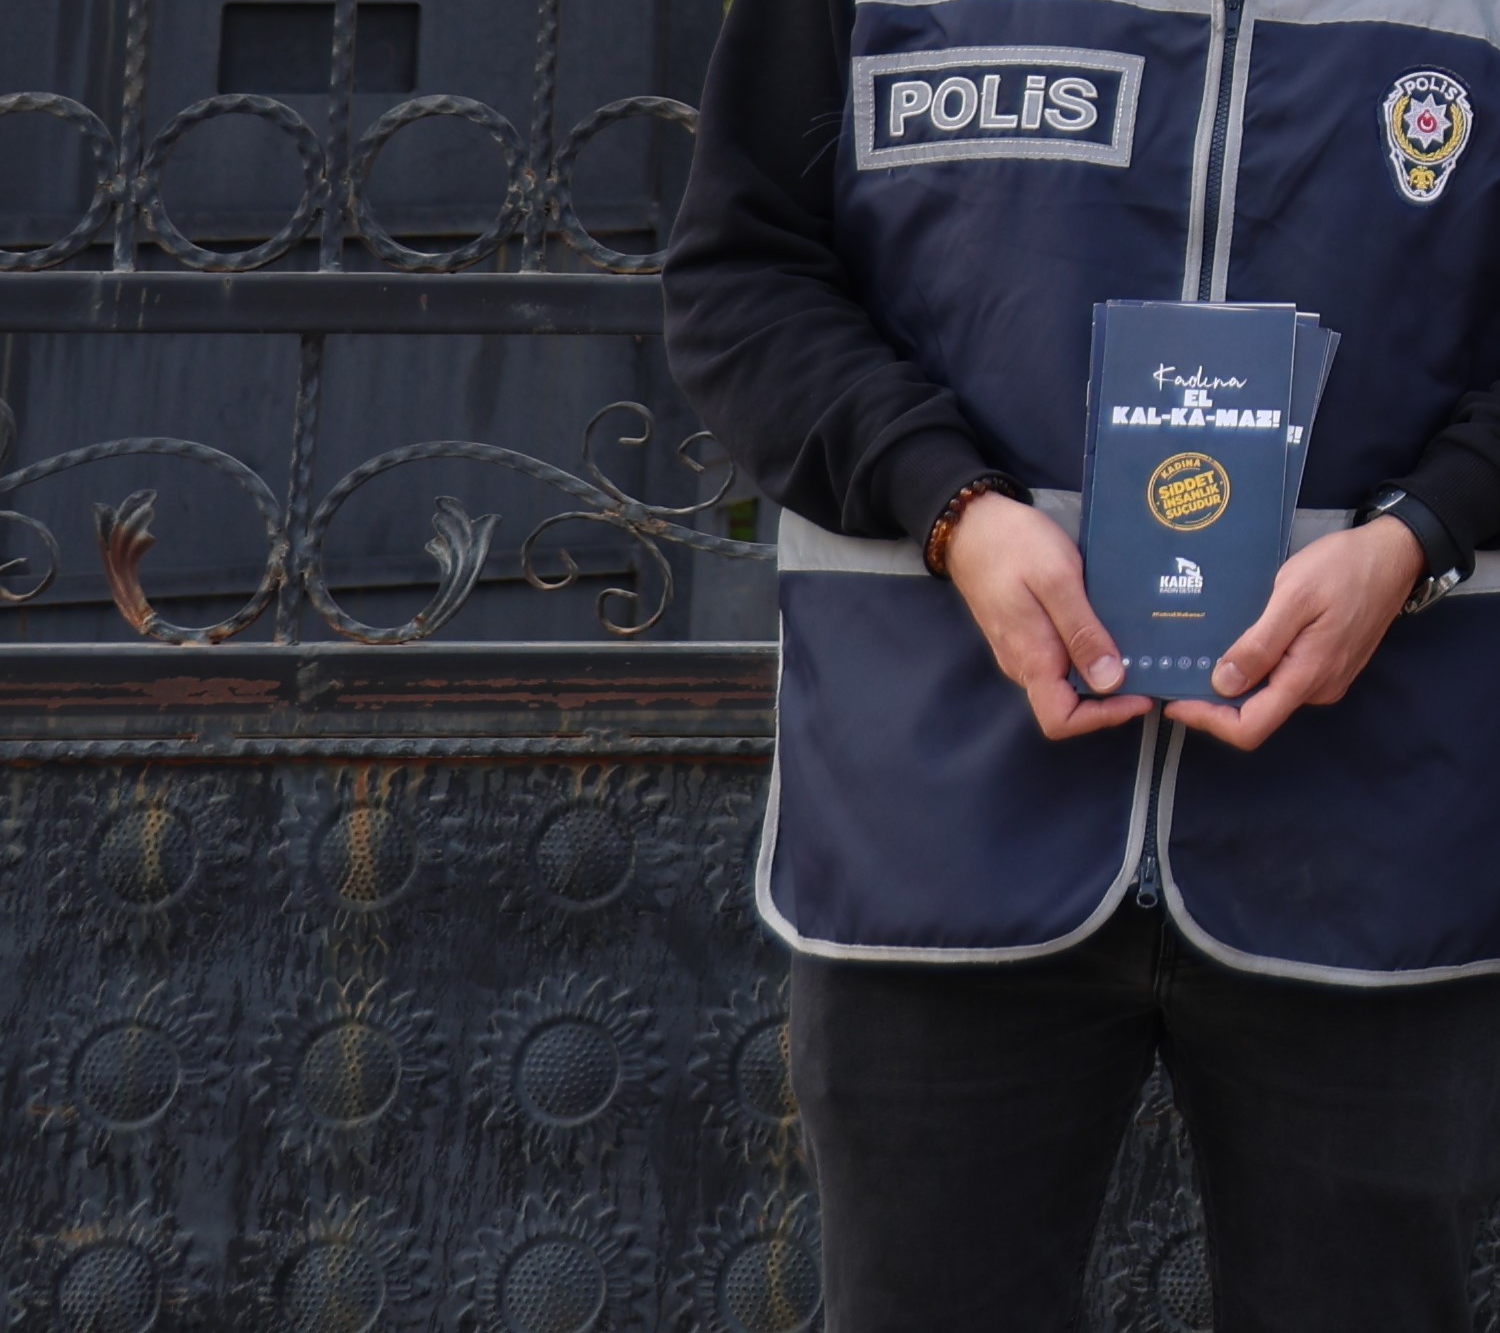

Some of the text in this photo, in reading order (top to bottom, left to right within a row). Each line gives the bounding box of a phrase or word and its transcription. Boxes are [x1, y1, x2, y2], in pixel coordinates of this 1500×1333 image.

[1404, 76, 1458, 101] POLİS
[888, 74, 1100, 136] POLİS
[1184, 389, 1213, 407] EL
[1112, 406, 1282, 428] KAL-KA-MAZ!
[1160, 458, 1201, 480] KADINA
[1159, 575, 1203, 589] KADES
